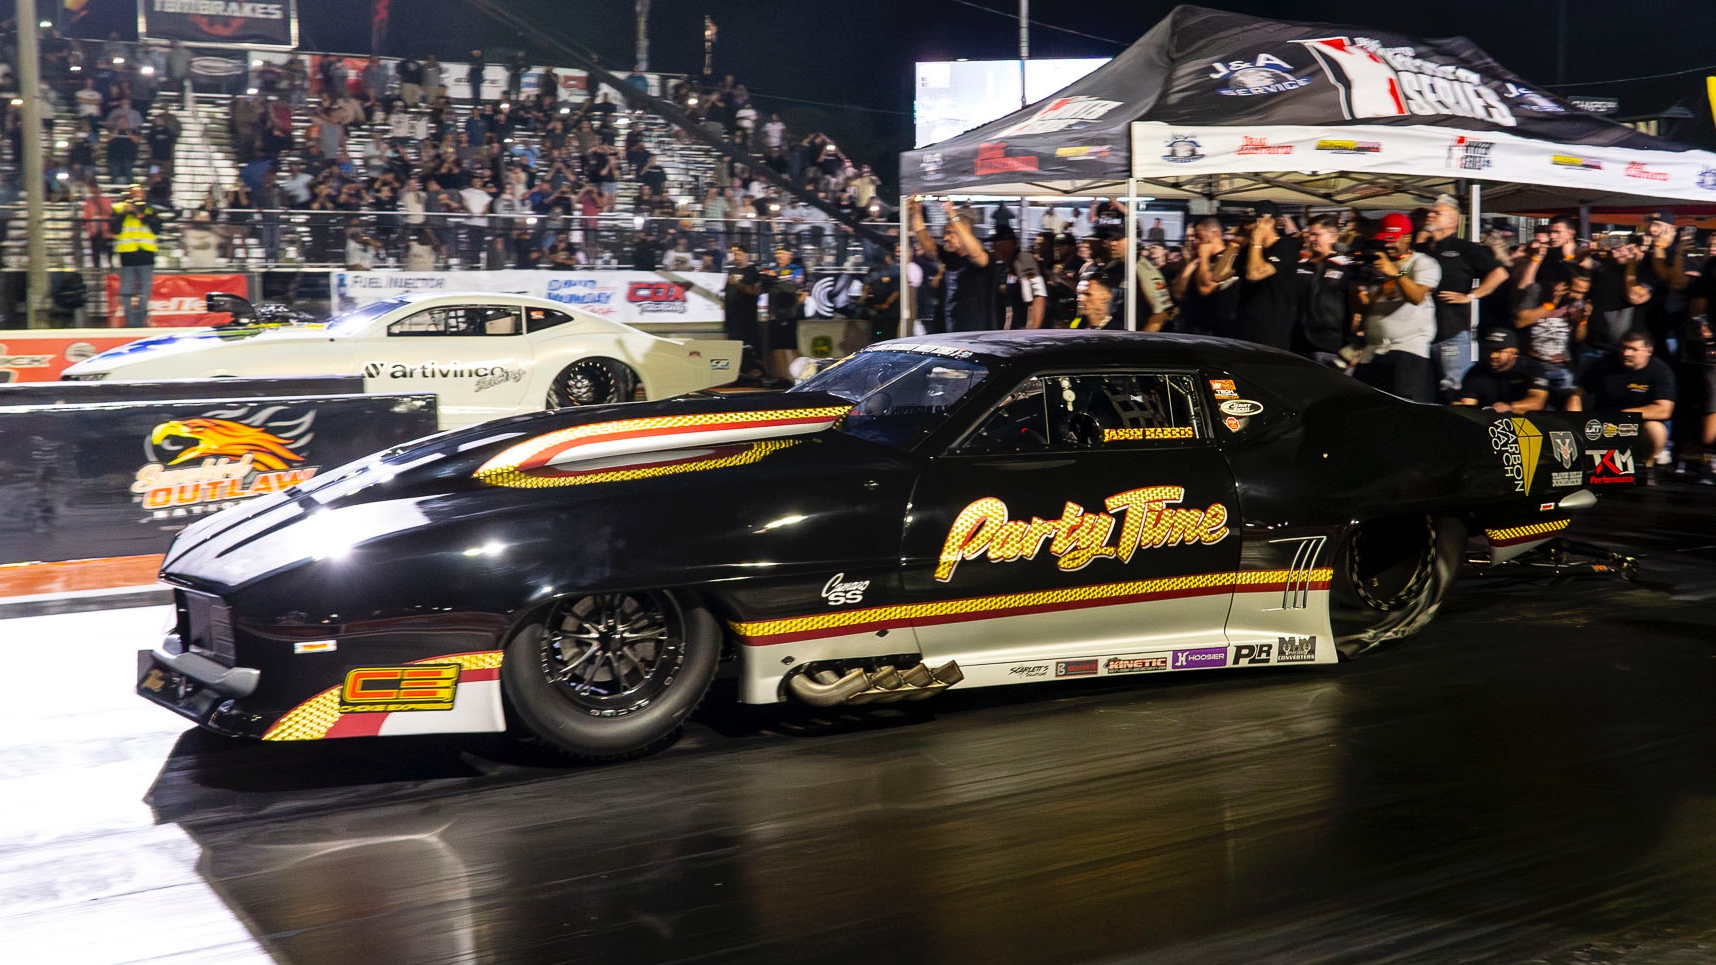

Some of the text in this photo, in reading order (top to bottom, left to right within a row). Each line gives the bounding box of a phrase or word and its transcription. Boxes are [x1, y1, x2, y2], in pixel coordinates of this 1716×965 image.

[1209, 53, 1294, 79] J&A
[1220, 78, 1309, 96] SERVICE
[1397, 70, 1517, 127] SERIES
[352, 275, 383, 289] FUEL
[626, 281, 687, 302] COX
[390, 362, 504, 379] artivinco
[1103, 427, 1194, 442] JASON HARRIS
[1488, 426, 1501, 454] CO.
[1493, 419, 1514, 477] WATCH
[1502, 418, 1525, 492] CARBON
[142, 468, 318, 509] OUTLAW
[934, 485, 1229, 582] Party Time
[821, 572, 870, 598] Camaro
[828, 590, 863, 605] SS
[1107, 658, 1168, 670] KINETIC
[1188, 653, 1225, 661] HOOSIER
